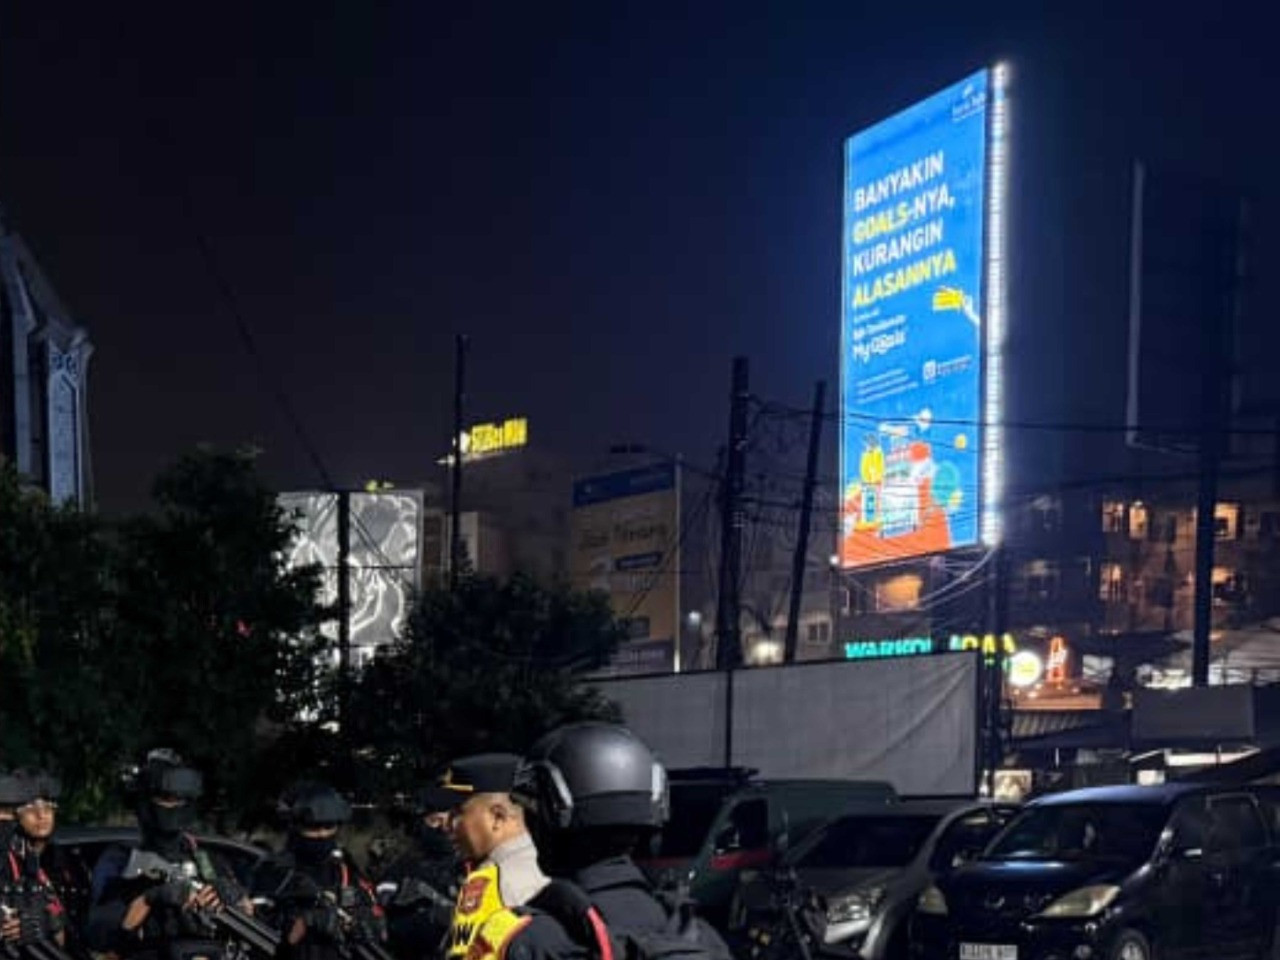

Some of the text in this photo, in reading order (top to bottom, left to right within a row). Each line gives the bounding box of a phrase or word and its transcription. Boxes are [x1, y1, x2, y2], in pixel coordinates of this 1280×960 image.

[853, 149, 944, 213] BANYAKIN
[853, 215, 944, 277] KURANGIN
[851, 247, 957, 309] ALASANNYA
